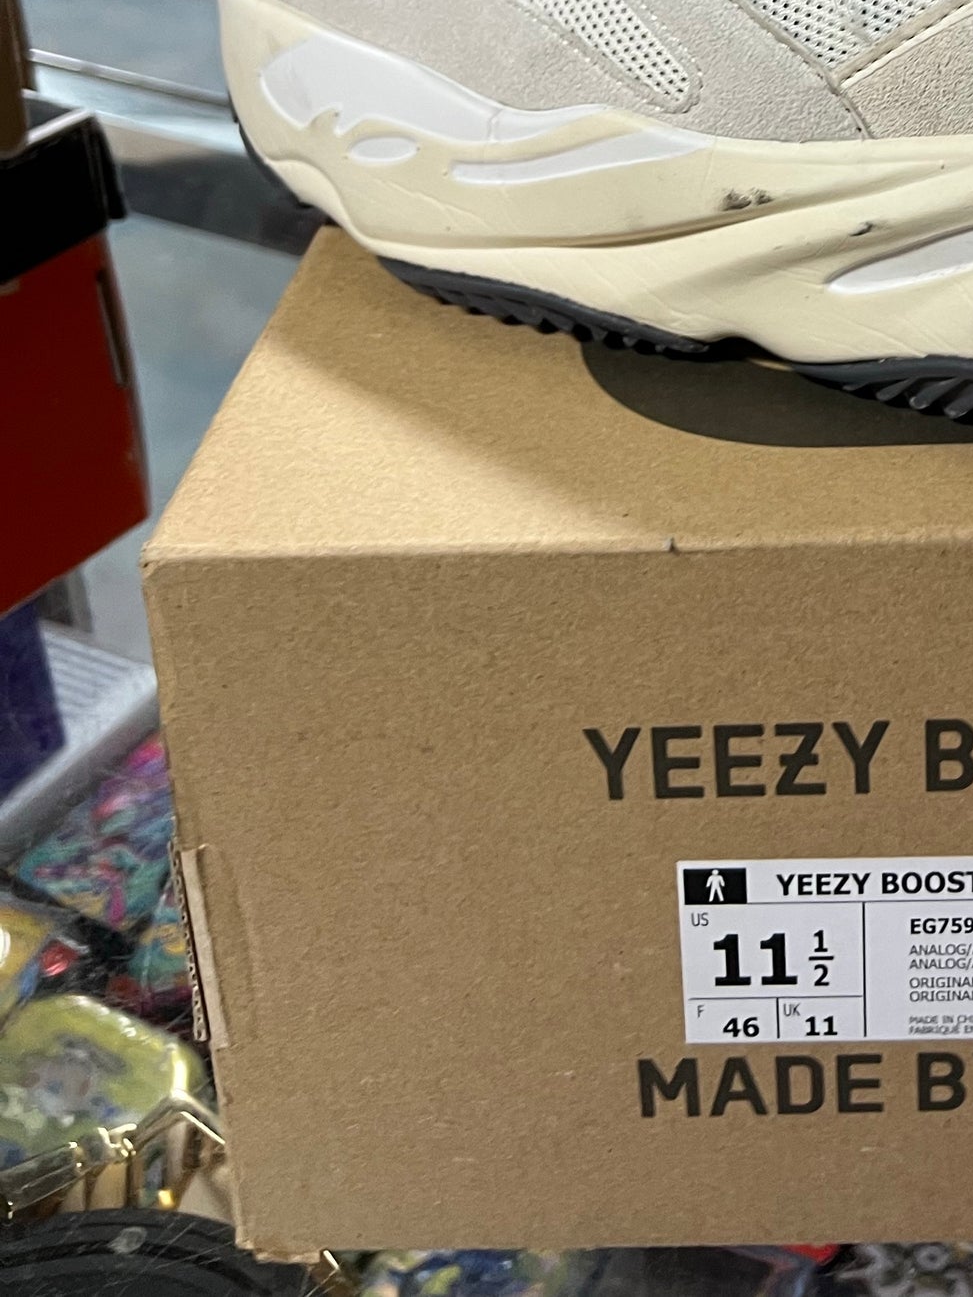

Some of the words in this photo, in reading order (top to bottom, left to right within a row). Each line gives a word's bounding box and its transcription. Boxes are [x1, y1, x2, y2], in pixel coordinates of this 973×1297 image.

[583, 720, 890, 800] YEEZY
[776, 873, 871, 896] YEEZY
[691, 912, 709, 927] US
[713, 932, 798, 987] 11
[783, 1004, 801, 1017] UK
[722, 1016, 760, 1038] 46
[805, 1015, 838, 1036] 11
[636, 1053, 884, 1120] MADE
